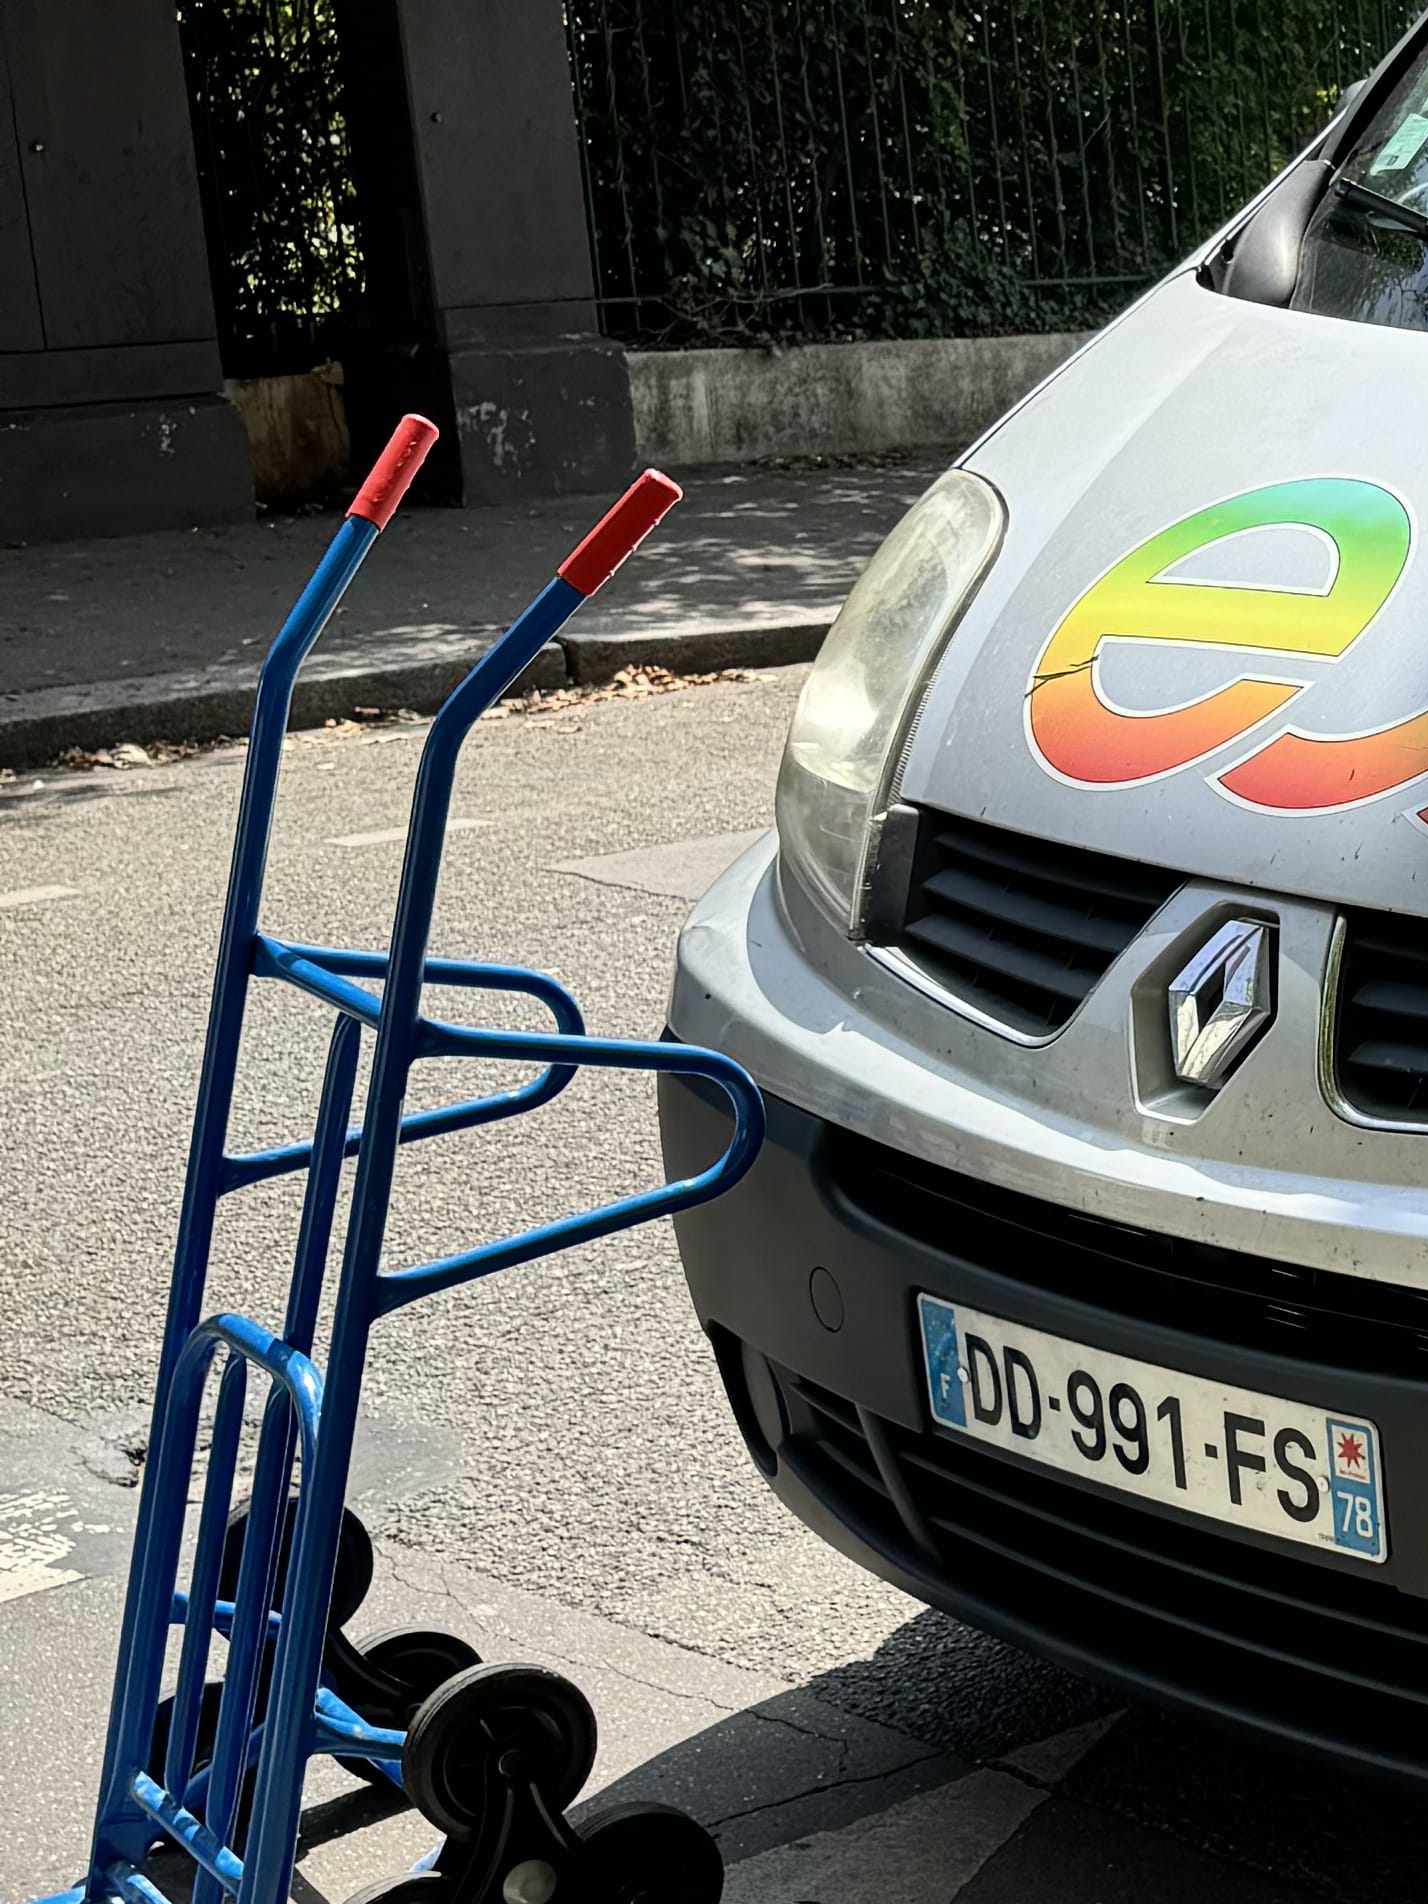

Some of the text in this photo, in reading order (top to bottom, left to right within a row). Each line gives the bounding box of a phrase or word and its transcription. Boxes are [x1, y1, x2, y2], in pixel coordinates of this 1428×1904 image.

[939, 1372, 951, 1400] F
[965, 1332, 1321, 1524] DD-991-FS
[1337, 1490, 1374, 1538] 78
